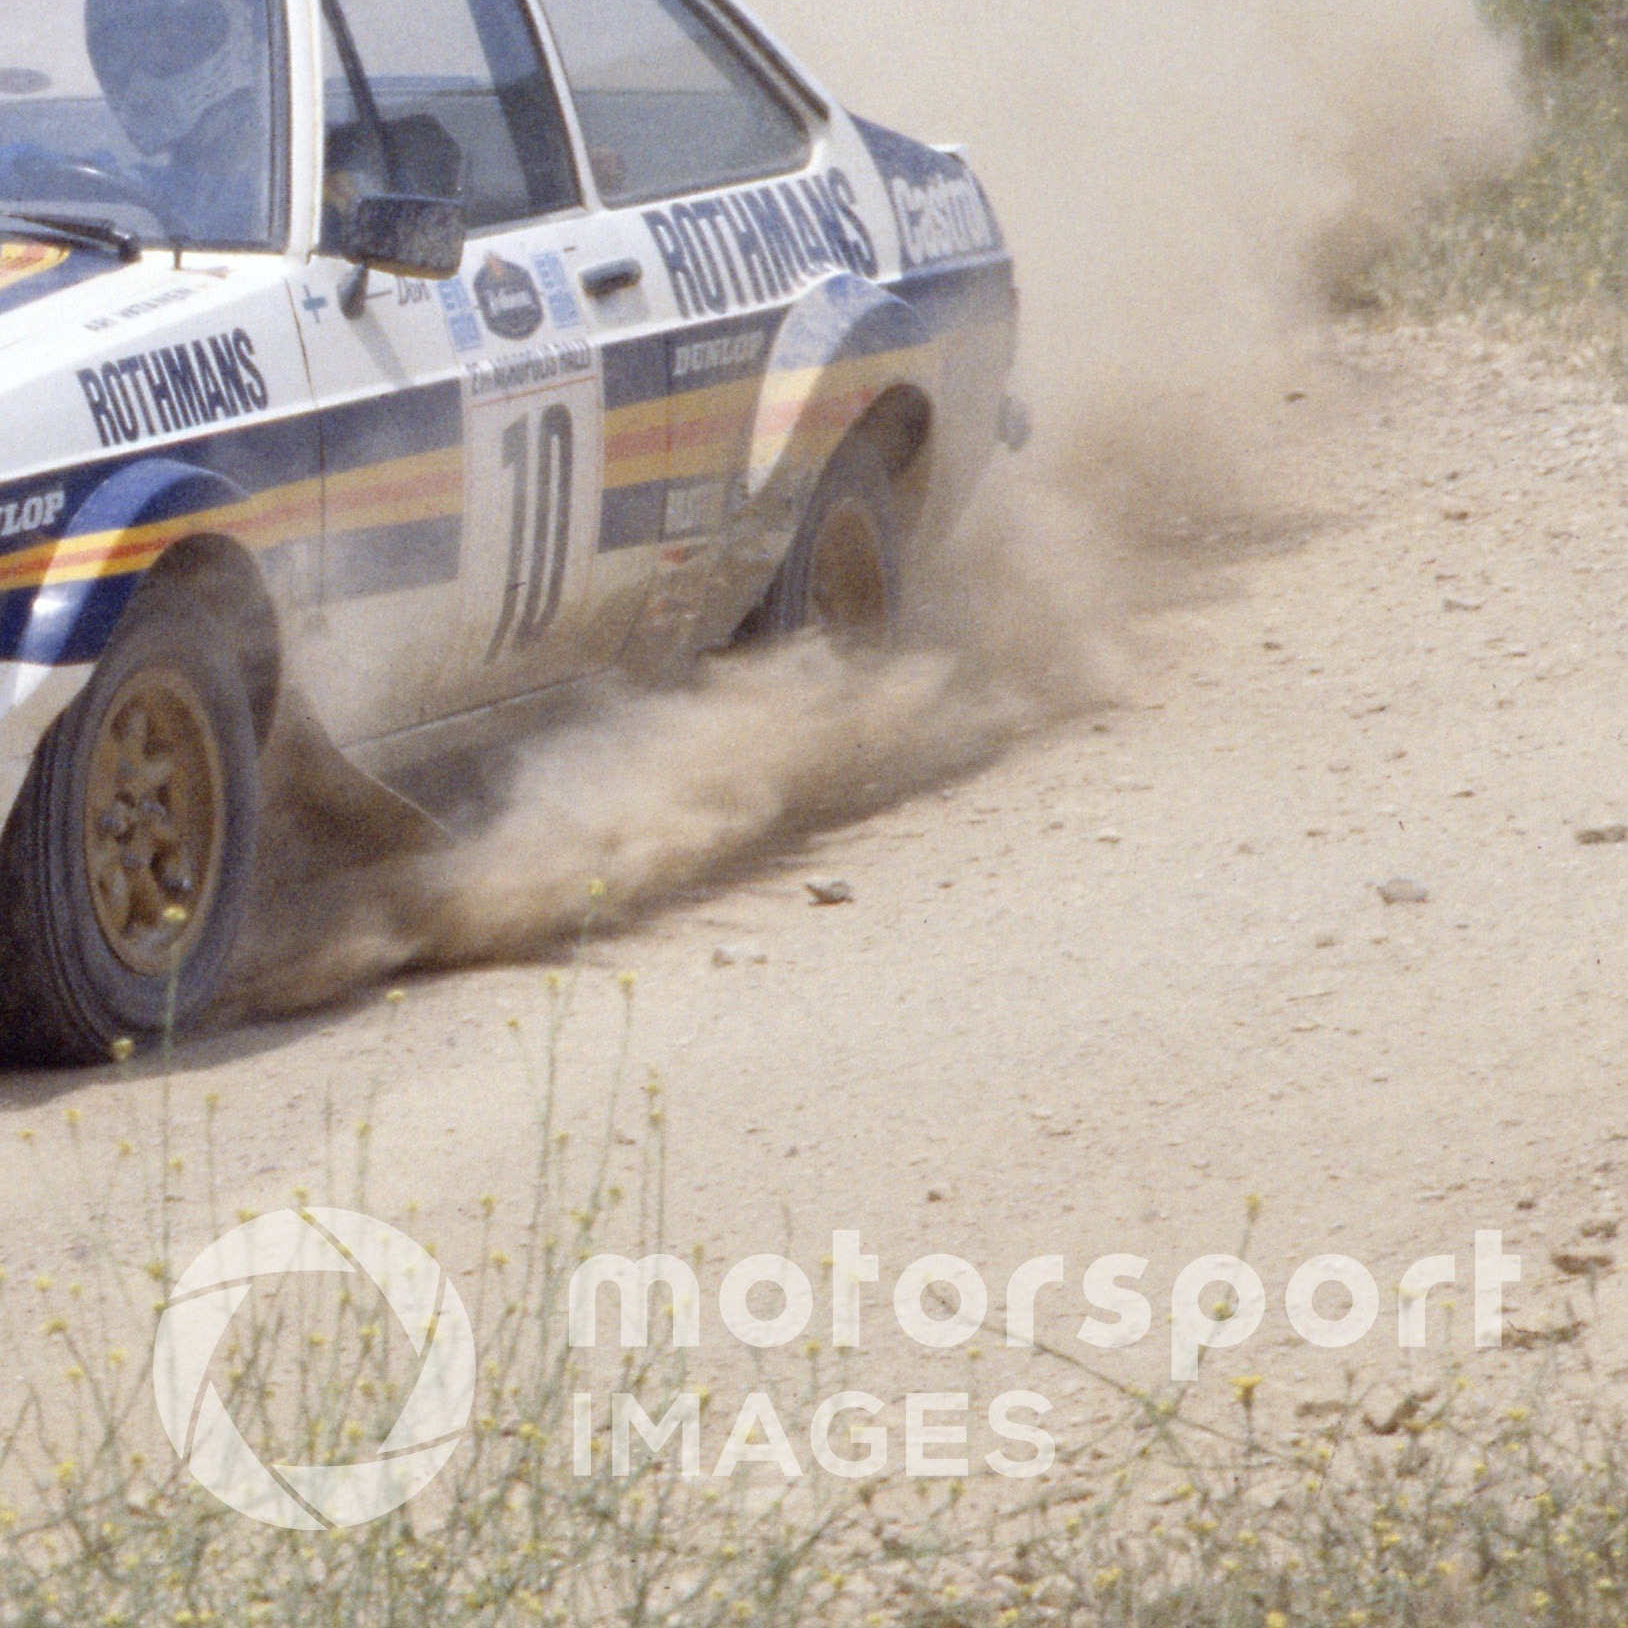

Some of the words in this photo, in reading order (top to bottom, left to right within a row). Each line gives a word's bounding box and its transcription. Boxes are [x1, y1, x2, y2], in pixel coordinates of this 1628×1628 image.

[640, 166, 880, 320] ROTHMANS
[76, 327, 269, 448] ROTHMANS
[483, 403, 573, 665] 10
